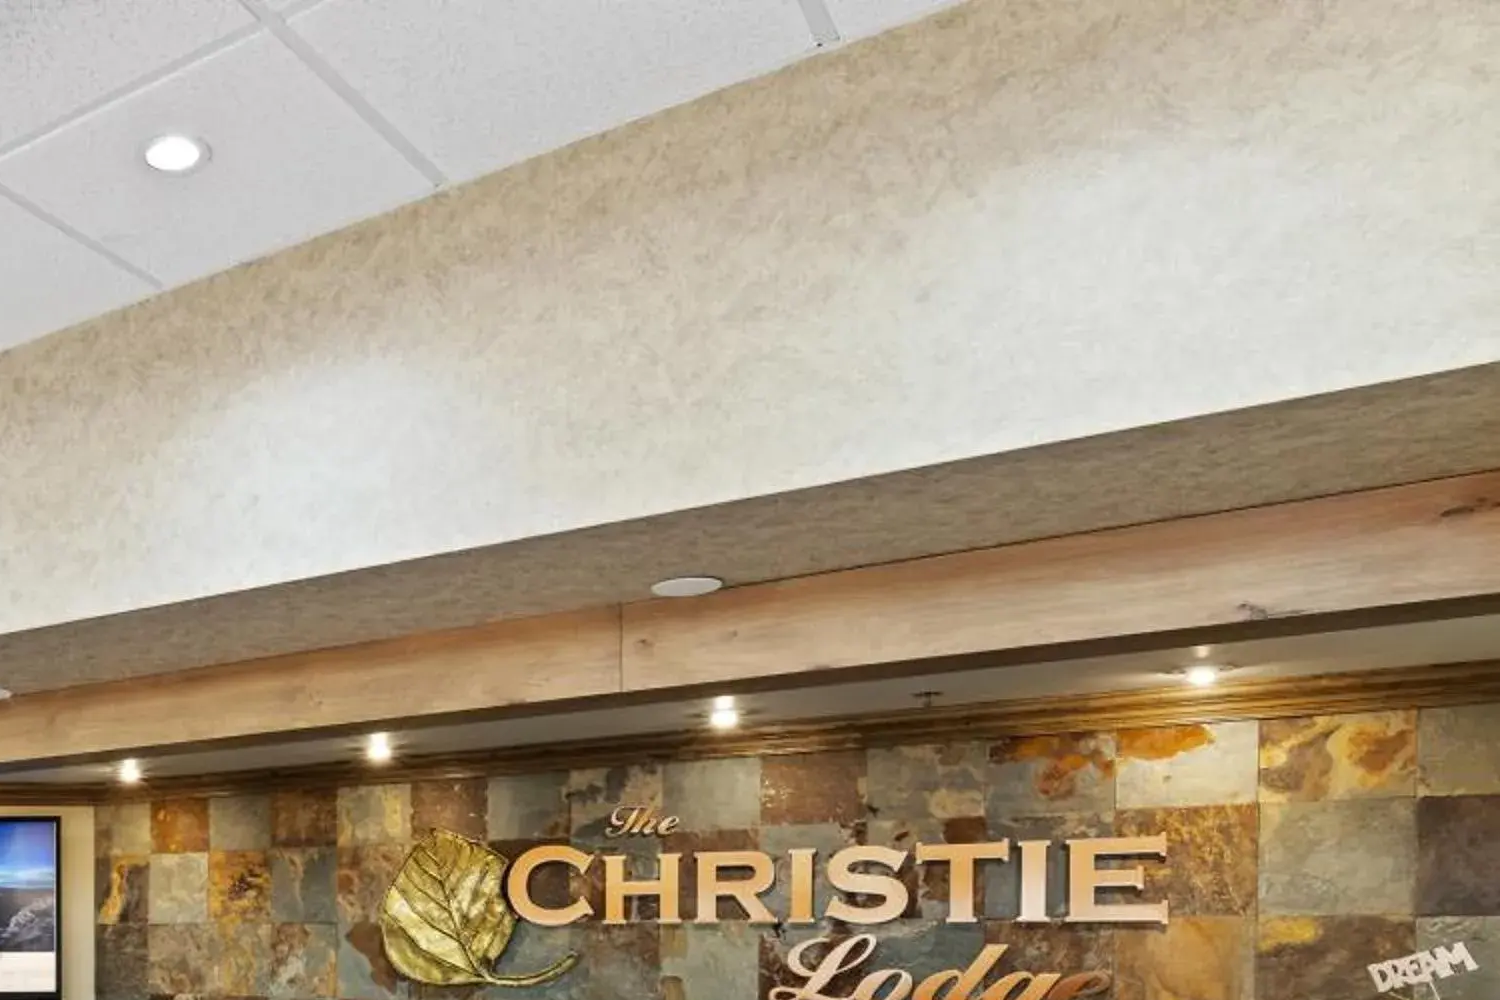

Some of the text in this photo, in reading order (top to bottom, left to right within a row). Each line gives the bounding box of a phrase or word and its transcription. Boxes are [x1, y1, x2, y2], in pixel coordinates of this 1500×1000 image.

[605, 806, 681, 837] The
[507, 832, 1169, 926] CHRISTIE
[1366, 941, 1479, 993] DREAM
